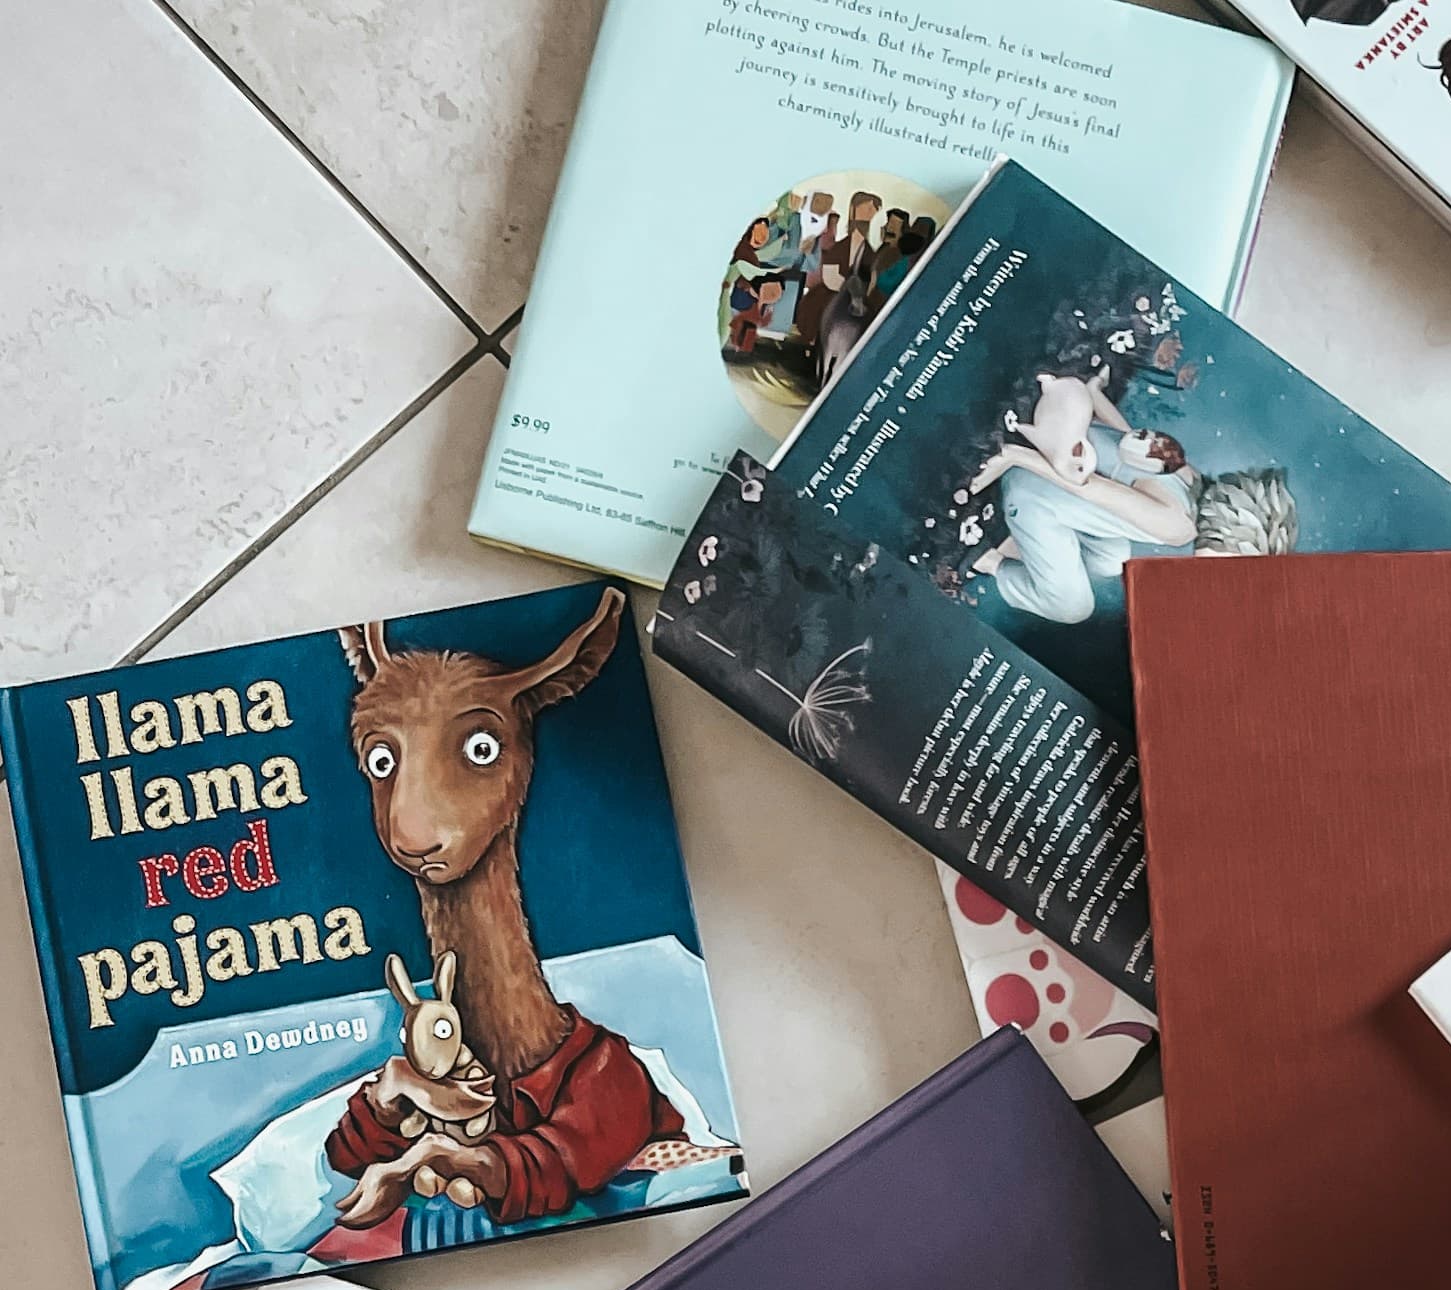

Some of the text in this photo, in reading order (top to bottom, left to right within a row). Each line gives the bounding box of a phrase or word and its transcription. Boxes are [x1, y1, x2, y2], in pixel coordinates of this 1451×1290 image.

[743, 0, 810, 33] cheering
[876, 30, 906, 53] But
[910, 40, 935, 60] the
[939, 47, 992, 78] Temple
[994, 66, 1048, 93] priests
[1053, 83, 1078, 98] are
[1082, 90, 1118, 110] soon
[878, 7, 910, 25] into
[998, 34, 1016, 53] he
[1020, 44, 1034, 58] is
[1040, 48, 1114, 78] welcomed
[1354, 7, 1419, 70] SMIETANKA
[1390, 17, 1429, 60] ART BY
[704, 16, 766, 50] plotting
[770, 36, 825, 63] against
[870, 58, 898, 79] The
[901, 70, 957, 100] moving
[960, 86, 1002, 112] story
[1005, 94, 1027, 118] of
[1026, 100, 1080, 130] Jesus's
[1082, 115, 1121, 142] final
[734, 55, 1071, 154] journey is sensitively brought to life in this
[776, 92, 864, 132] charmingly
[868, 116, 948, 150] illustrated
[960, 264, 979, 284] the
[972, 236, 1001, 267] From
[982, 248, 1028, 298] Written
[926, 314, 942, 332] of
[936, 280, 966, 318] author
[966, 294, 990, 317] by
[944, 313, 978, 352] Kobi
[904, 348, 952, 402] Yamada
[510, 412, 551, 434] $9.99
[844, 418, 900, 488] Illustrated
[1010, 674, 1032, 697] She
[66, 678, 293, 764] llama
[984, 694, 1016, 736] remains
[1048, 700, 1068, 722] her
[1016, 718, 1054, 768] collection
[1047, 713, 1086, 762] Gabriella
[80, 754, 308, 841] llama
[956, 768, 972, 784] in
[137, 819, 280, 909] red
[77, 905, 373, 1030] pajama
[168, 1015, 368, 1069] Anna Dewdney
